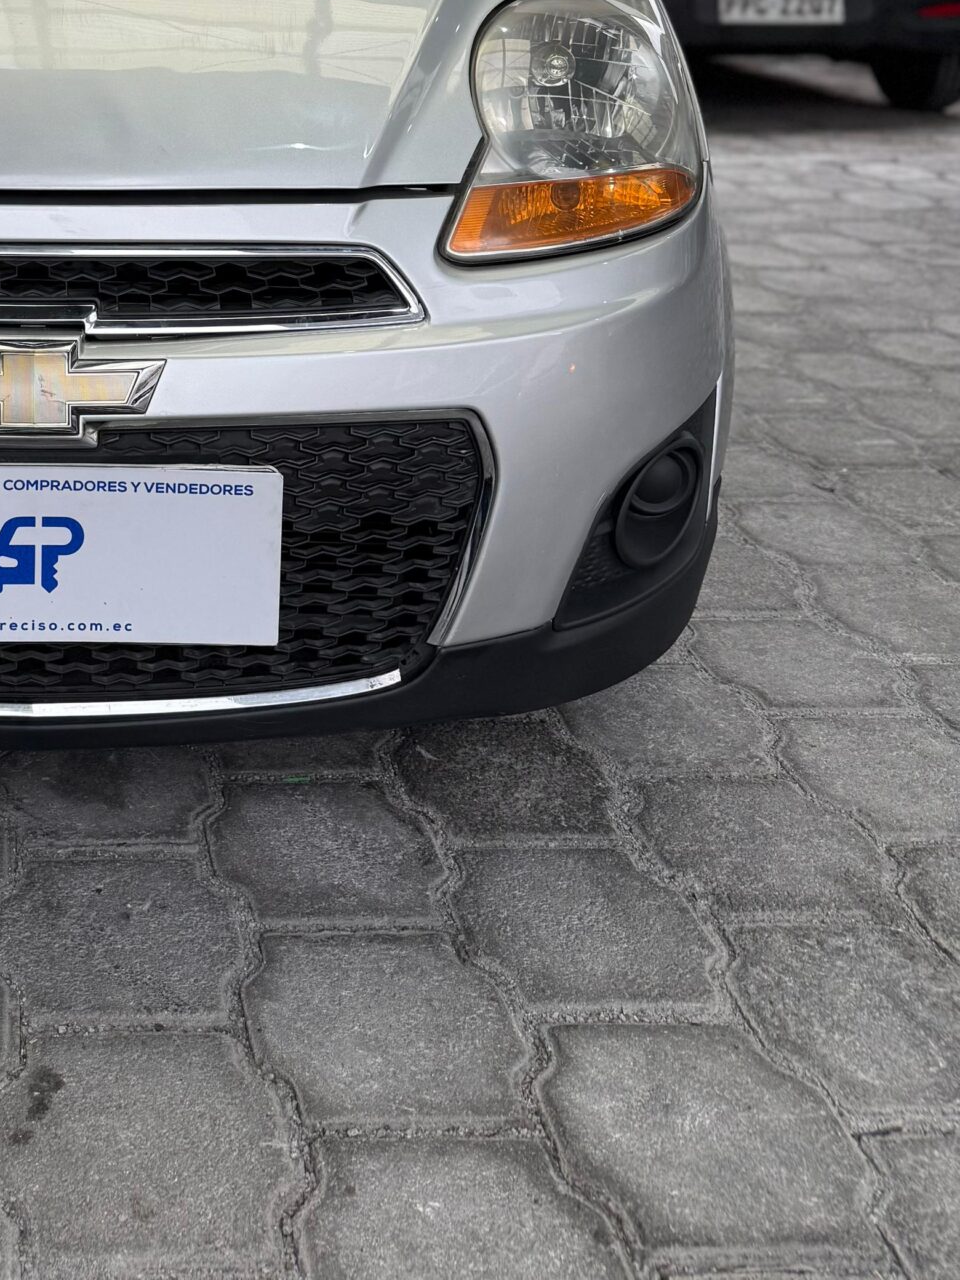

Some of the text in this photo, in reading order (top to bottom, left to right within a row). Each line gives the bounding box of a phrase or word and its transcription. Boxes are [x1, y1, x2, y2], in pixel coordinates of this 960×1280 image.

[3, 479, 128, 494] COMPRADORES
[132, 481, 143, 494] Y
[144, 481, 254, 497] VENDEDORES
